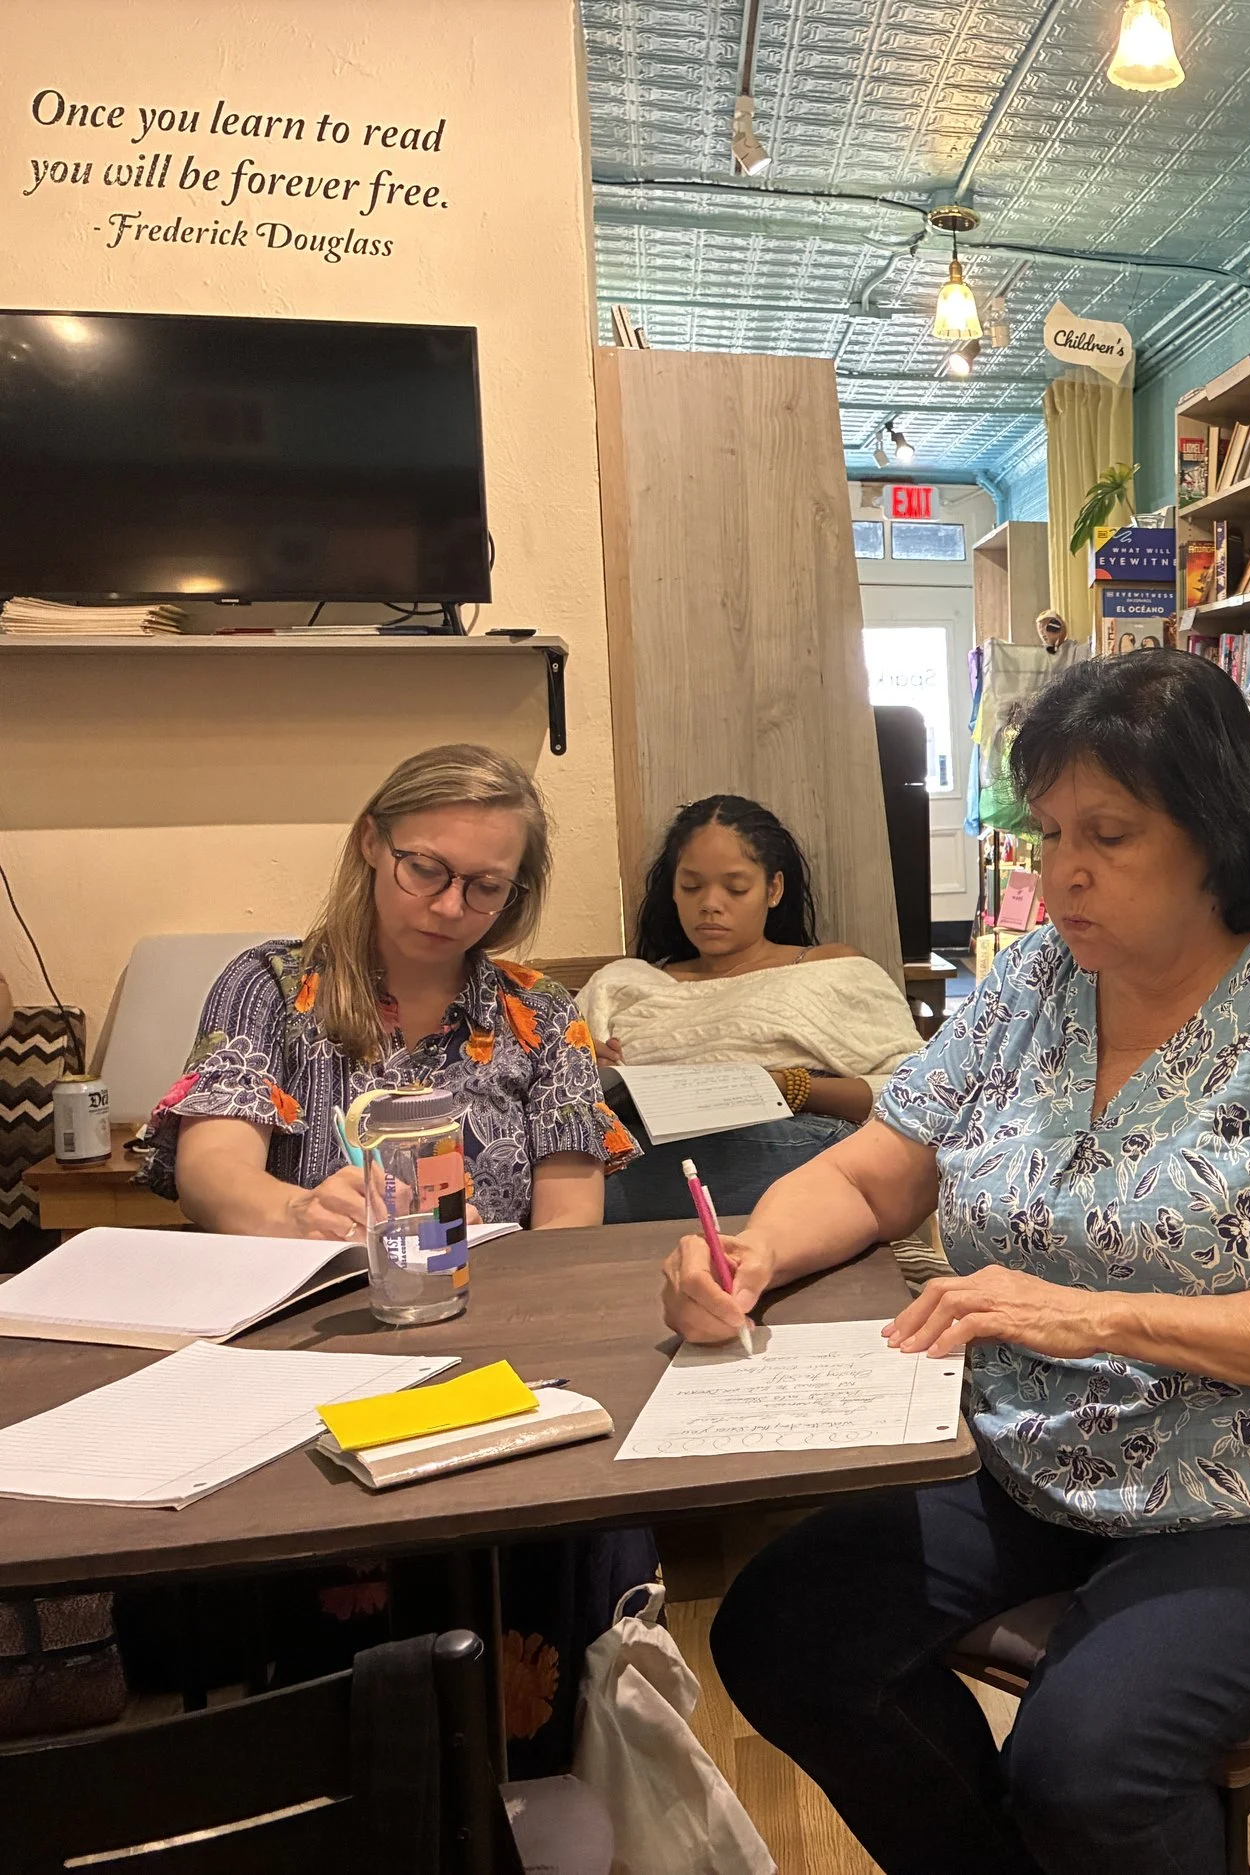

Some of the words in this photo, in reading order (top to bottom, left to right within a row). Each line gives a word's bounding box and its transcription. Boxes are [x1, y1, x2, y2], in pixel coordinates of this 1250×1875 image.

[32, 89, 125, 129] Once
[131, 107, 200, 144] you
[210, 100, 305, 140] learn
[316, 114, 350, 144] to
[363, 119, 446, 152] read
[23, 159, 93, 196] you
[103, 153, 173, 188] will
[179, 155, 220, 191] be
[221, 158, 360, 206] forever
[359, 169, 448, 217] free.
[255, 221, 394, 264] Douglass
[1053, 329, 1125, 357] Children's
[892, 487, 933, 518] EXIT
[1128, 605, 1165, 614] OCÉANO
